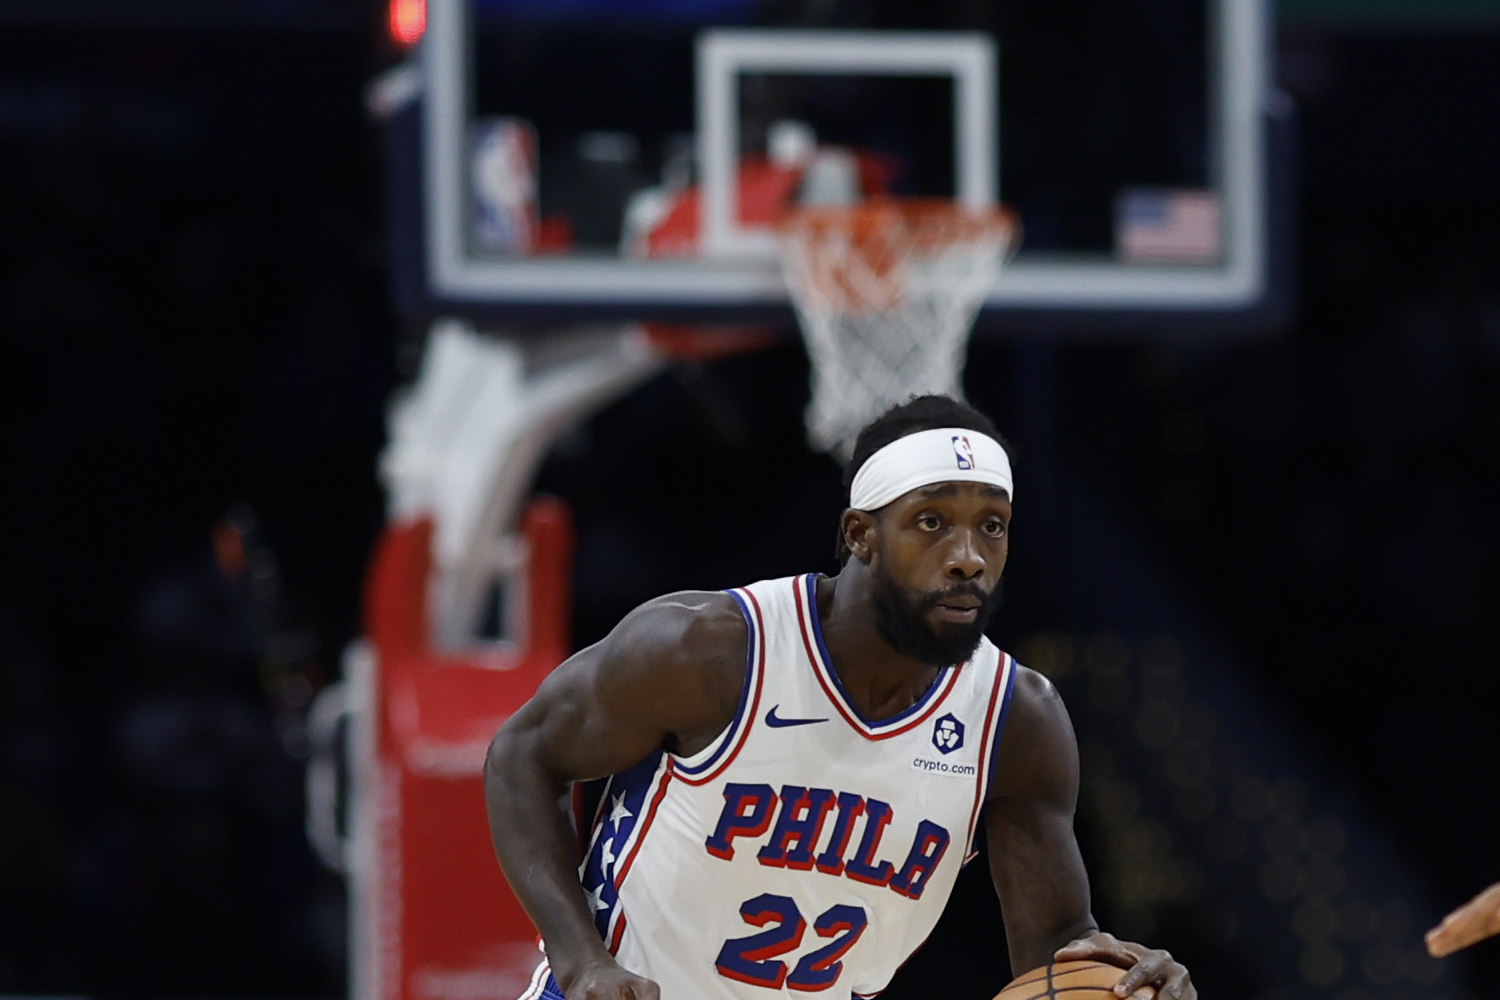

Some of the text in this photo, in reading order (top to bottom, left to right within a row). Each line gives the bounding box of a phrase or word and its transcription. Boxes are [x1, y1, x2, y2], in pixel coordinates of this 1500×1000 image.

[913, 758, 975, 775] crypto.com
[705, 782, 950, 900] PHILA
[715, 893, 868, 992] 22
